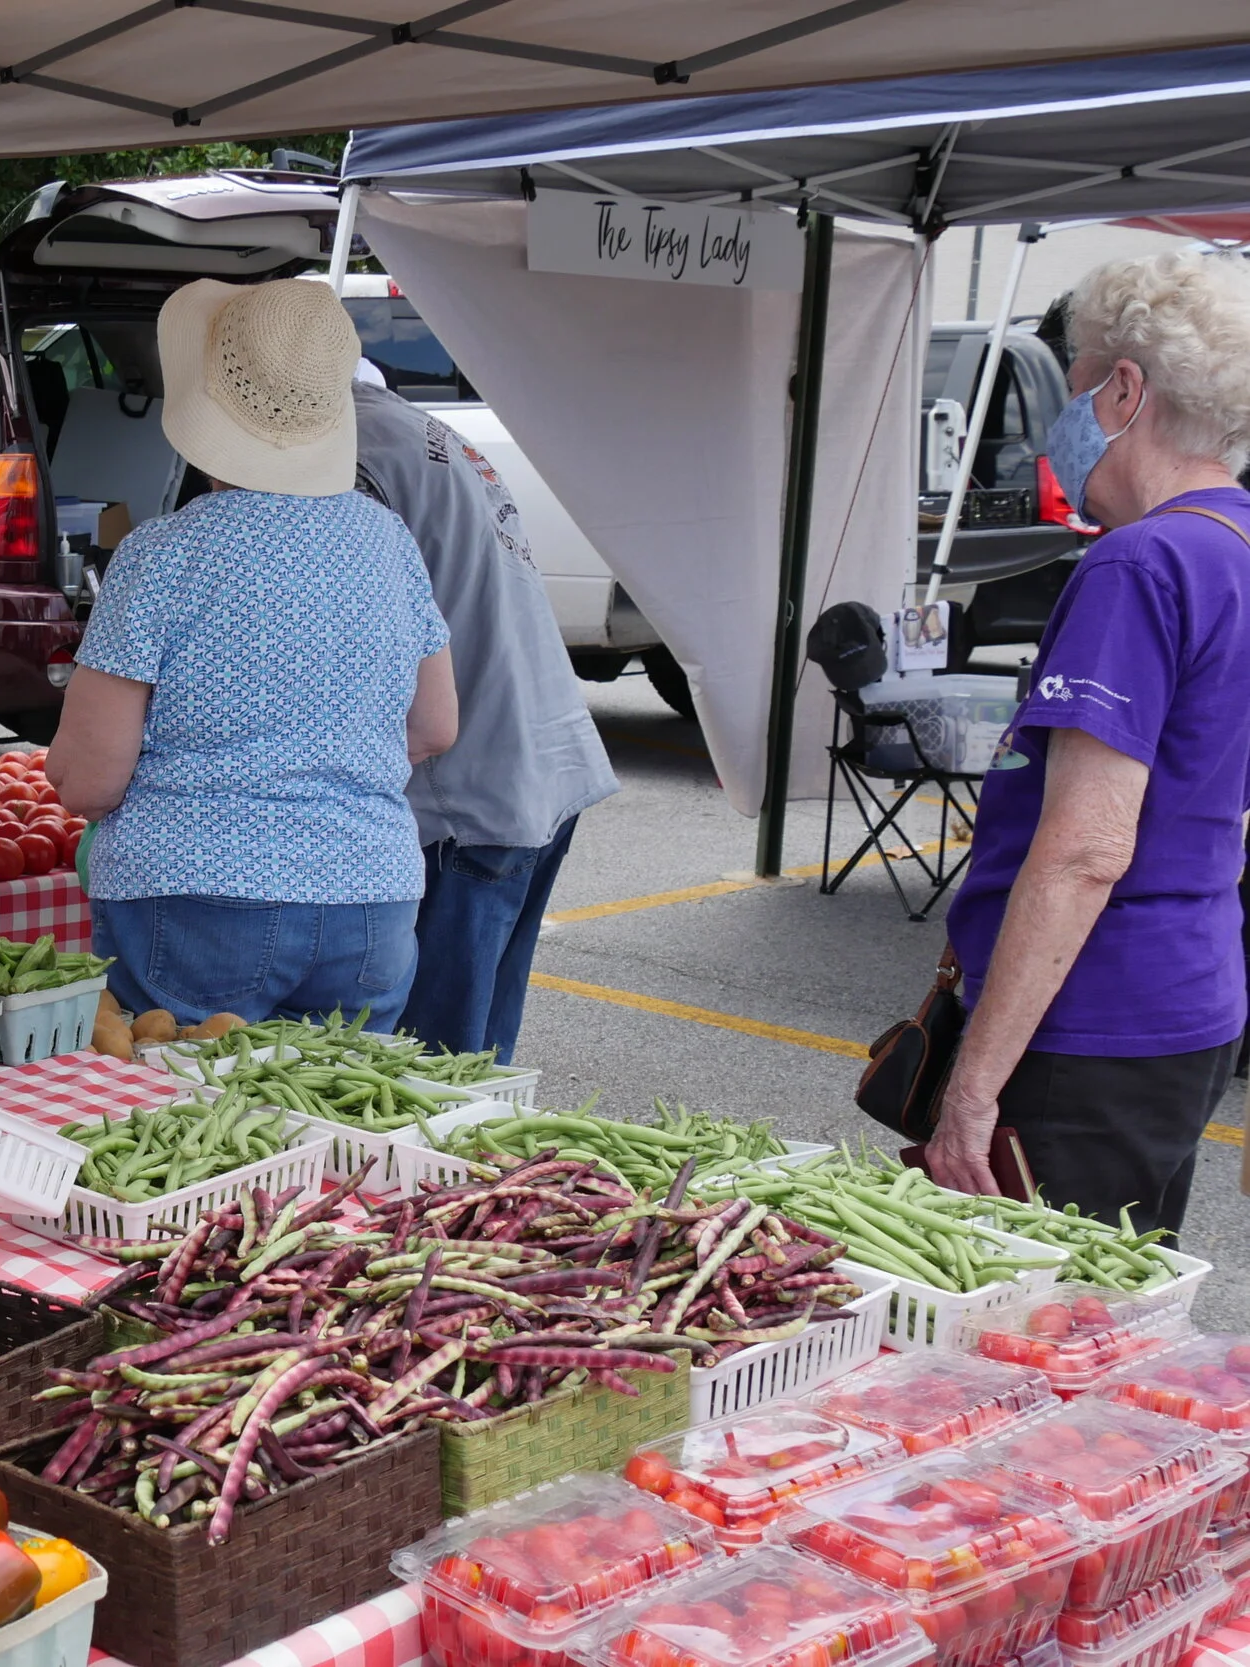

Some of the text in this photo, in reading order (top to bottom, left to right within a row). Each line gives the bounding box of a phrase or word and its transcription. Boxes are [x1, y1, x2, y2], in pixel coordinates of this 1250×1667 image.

[593, 200, 752, 286] The Tipsy Lady
